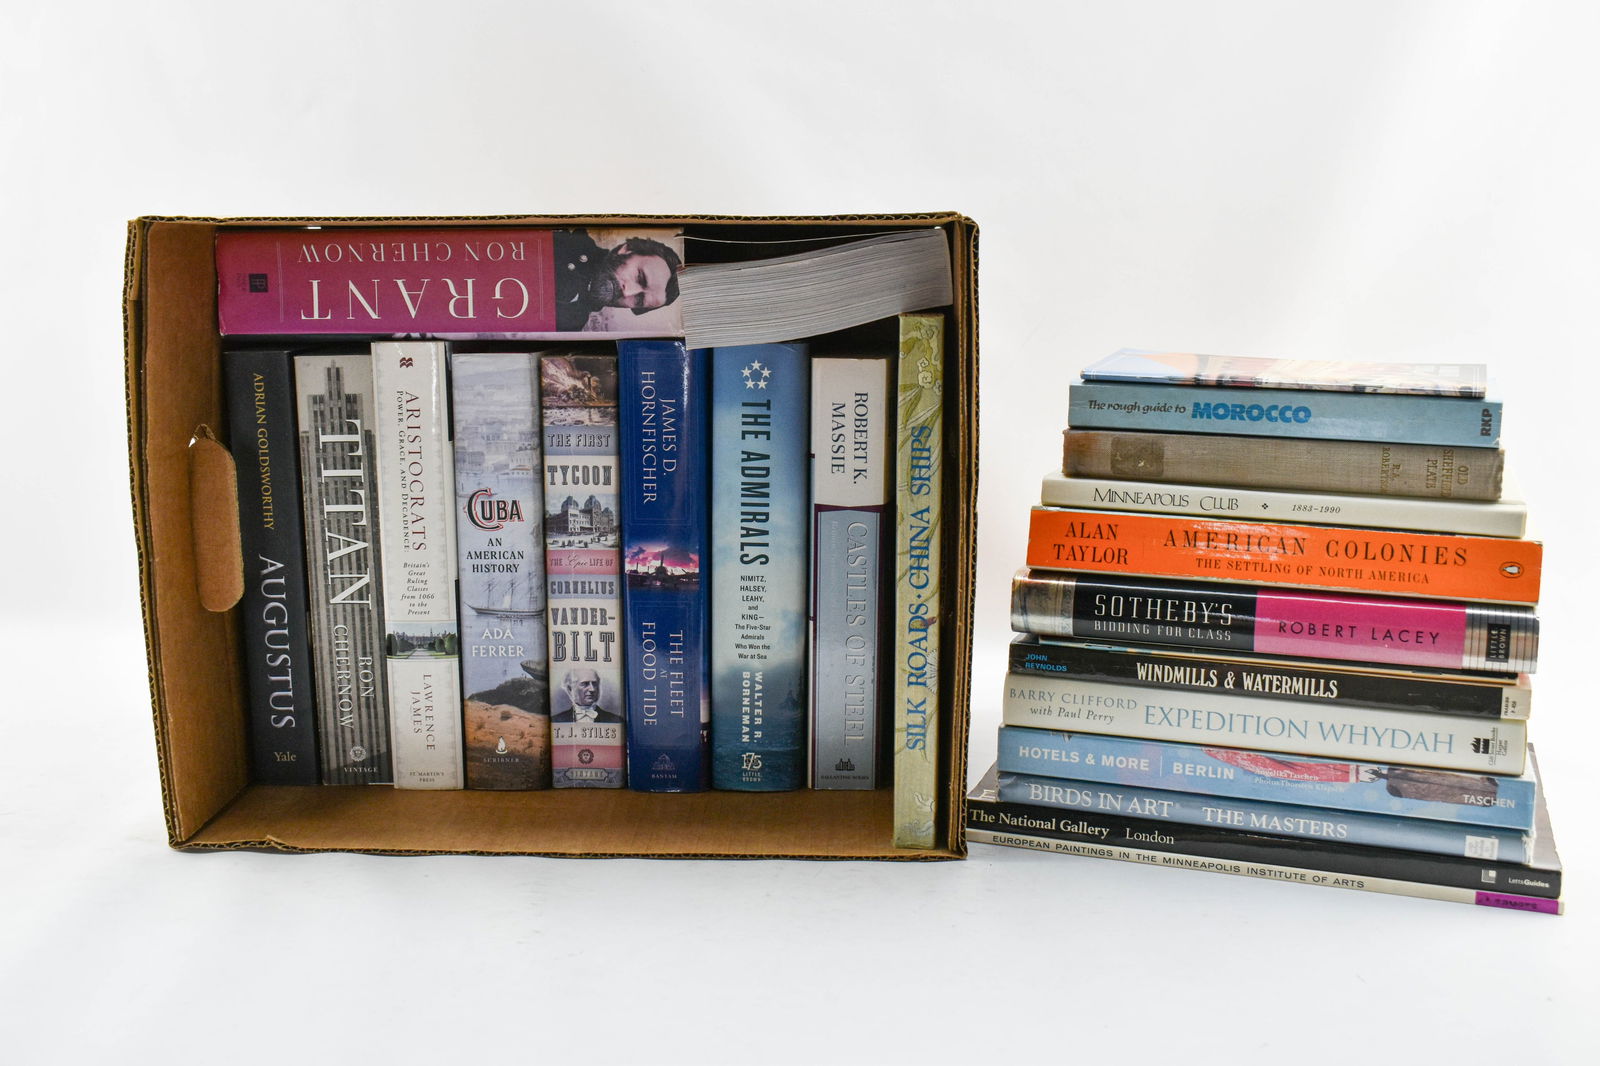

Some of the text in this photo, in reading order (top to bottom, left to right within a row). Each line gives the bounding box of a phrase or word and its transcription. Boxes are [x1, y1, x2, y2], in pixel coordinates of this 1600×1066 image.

[298, 242, 526, 264] RON CHERNOW
[300, 278, 530, 320] GRANT
[1088, 400, 1312, 424] The rough guide to MOROCCO
[1480, 408, 1493, 437] RKP
[253, 372, 274, 530] ADRIAN GOLDSWORTHY
[548, 434, 612, 447] THE FIRST
[640, 371, 657, 504] HORNFISCHER
[660, 398, 678, 476] JAMES D.
[830, 402, 846, 474] MASSIE
[853, 392, 869, 485] ROBERT K.
[405, 391, 426, 551] ARISTOCRATS
[547, 465, 613, 486] TYCOON
[740, 399, 771, 566] THE ADMIRALS
[1426, 459, 1438, 489] PLATE
[1457, 466, 1469, 486] OLD
[319, 419, 372, 610] TITAN
[1094, 488, 1190, 508] MINNEAPOLIS
[1200, 495, 1240, 512] CLUB
[487, 538, 502, 547] AN
[1064, 522, 1120, 541] ALAN
[466, 550, 524, 560] AMERICAN
[550, 554, 614, 568] THE Epic LIFE OF
[1053, 544, 1129, 566] TAYLOR
[1163, 530, 1468, 567] AMERICAN COLONIES
[406, 578, 428, 586] Ruling
[472, 564, 520, 573] HISTORY
[740, 576, 767, 584] NIMITZ,
[1196, 558, 1430, 584] THE SETTLING OF NORTH AMERICA
[550, 580, 614, 595] CORNELIUS
[740, 584, 767, 593] HALSEY,
[742, 595, 765, 603] LEAHY,
[906, 425, 932, 751] SILK ROADS CHINA SHIPS
[551, 608, 616, 626] VANDER-
[1094, 594, 1234, 626] SOTHEBY'S
[258, 555, 296, 728] AUGUSTUS
[482, 628, 514, 640] ADA
[844, 521, 868, 746] CASTLES OF STEEL
[1094, 620, 1232, 641] BIDDING FOR CLASS
[1278, 621, 1440, 644] ROBERT LACEY
[1498, 628, 1508, 659] BROWN
[472, 645, 525, 658] FERRER
[552, 631, 615, 662] BILT
[1025, 654, 1048, 662] JOHN
[334, 624, 354, 729] CHERNOW
[358, 656, 374, 698] RON
[642, 622, 658, 726] FLOOD TIDE
[660, 668, 668, 678] AT
[669, 630, 684, 718] THE FLEET
[1025, 662, 1068, 672] REYNOLDS
[1136, 662, 1338, 698] WINDMILLS & WATERMILLS
[411, 691, 422, 734] JAMES
[423, 674, 436, 751] LAWRENCE
[741, 671, 750, 743] BORNEMAN
[754, 671, 763, 743] WALTER R.
[1009, 688, 1138, 710] BARRY CLIFFORD
[1030, 706, 1114, 726] with Paul Perry
[1144, 705, 1456, 754] EXPEDITION WHYDAH
[582, 727, 617, 739] STILES
[274, 752, 296, 762] Yale
[1019, 746, 1235, 780] HOTELS & MORE BERLIN
[1028, 782, 1348, 838] BIRDS IN ART THE MASTERS
[1464, 794, 1516, 809] TASCHEN
[970, 808, 1175, 846] The National Gallery London
[992, 835, 1365, 888] EUROPEAN PAINTINGS IN THE MINNEAPOLIS INSTITUTE OF ARTS
